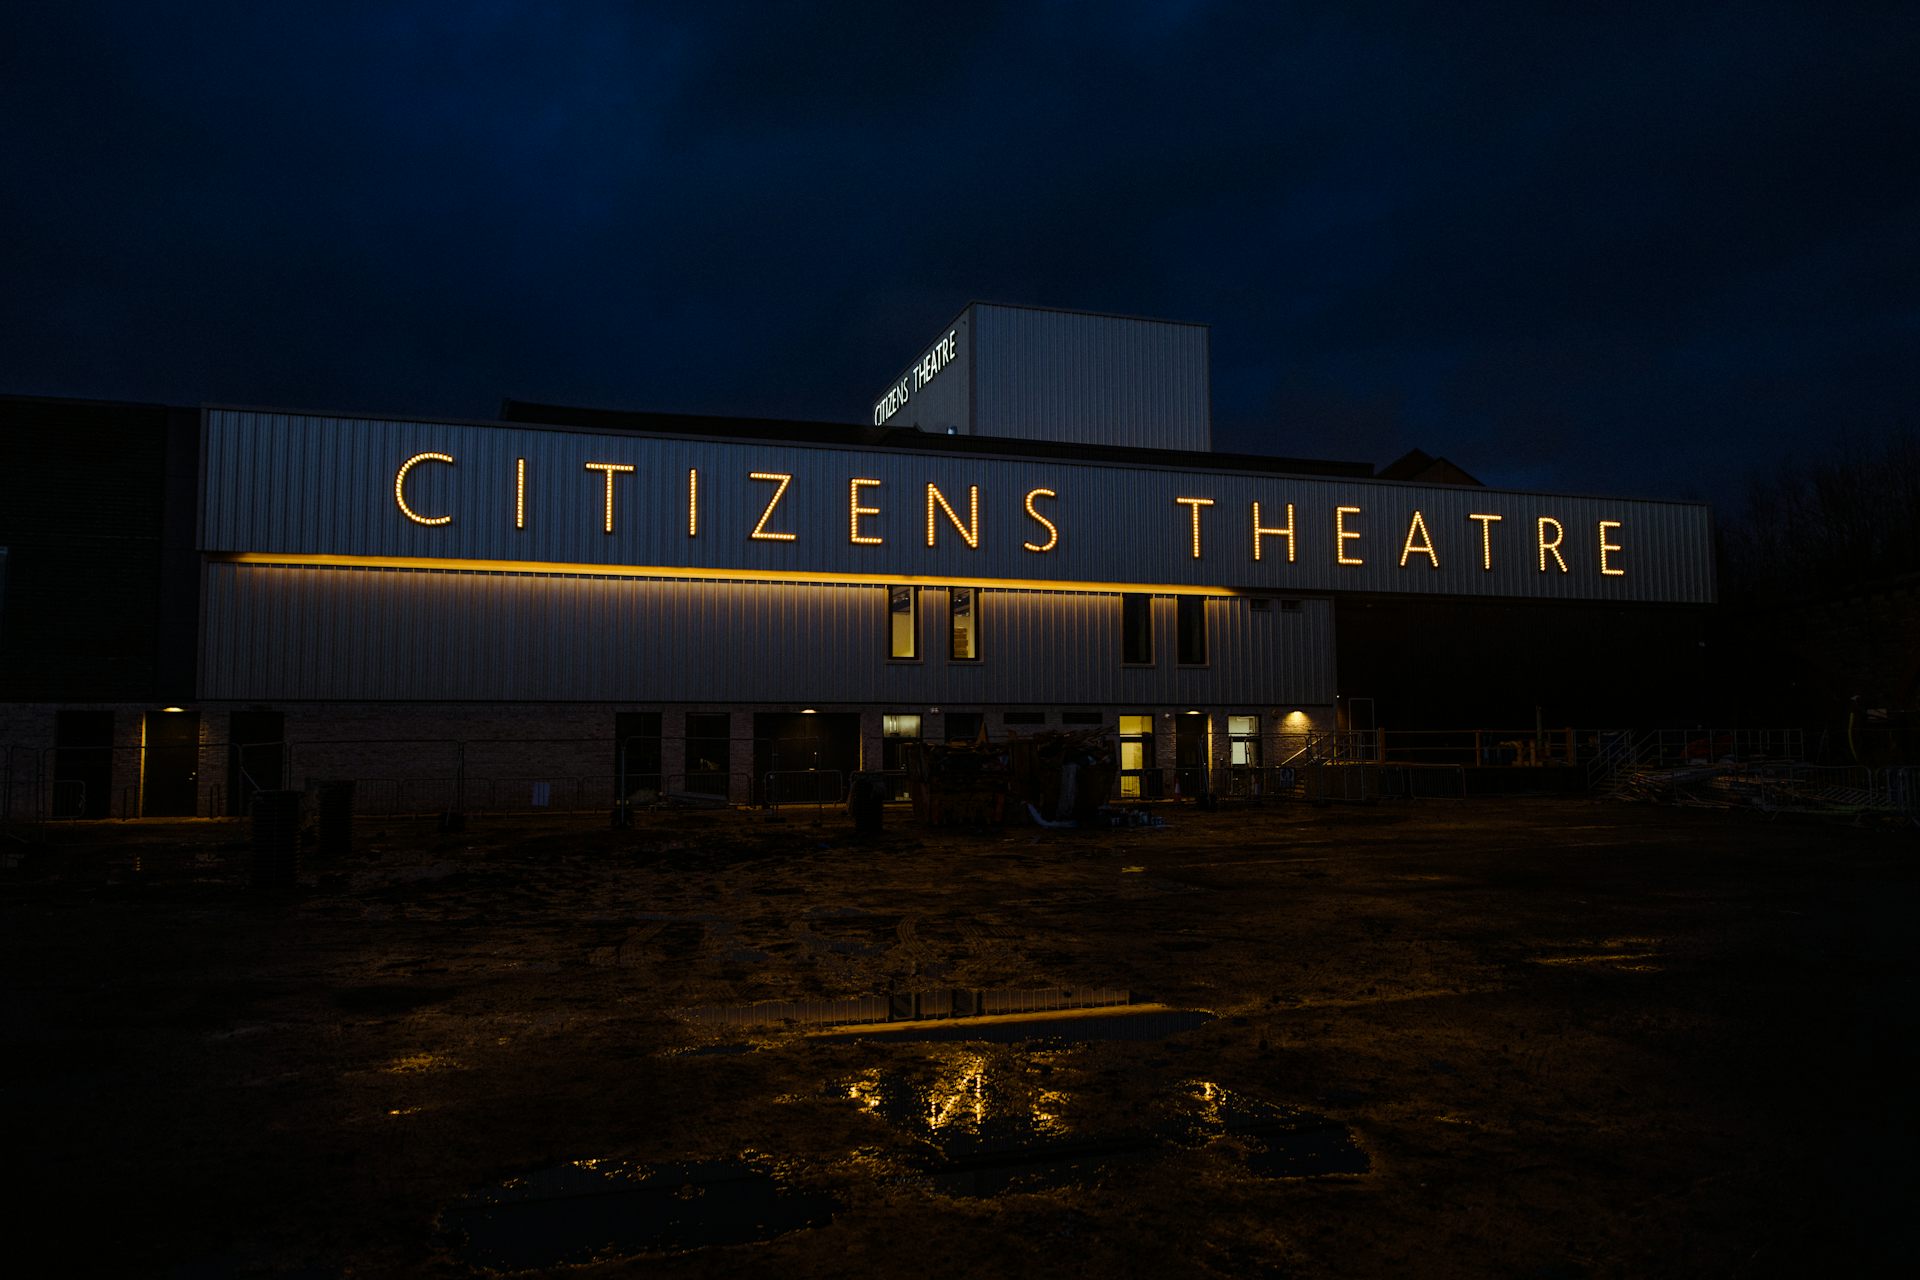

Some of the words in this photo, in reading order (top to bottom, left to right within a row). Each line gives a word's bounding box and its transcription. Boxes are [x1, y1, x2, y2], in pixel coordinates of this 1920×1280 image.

[874, 376, 908, 426] CITIZENS
[912, 329, 956, 393] THEATRE
[394, 451, 1058, 553] CITIZENS
[1175, 496, 1625, 577] THEATRE
